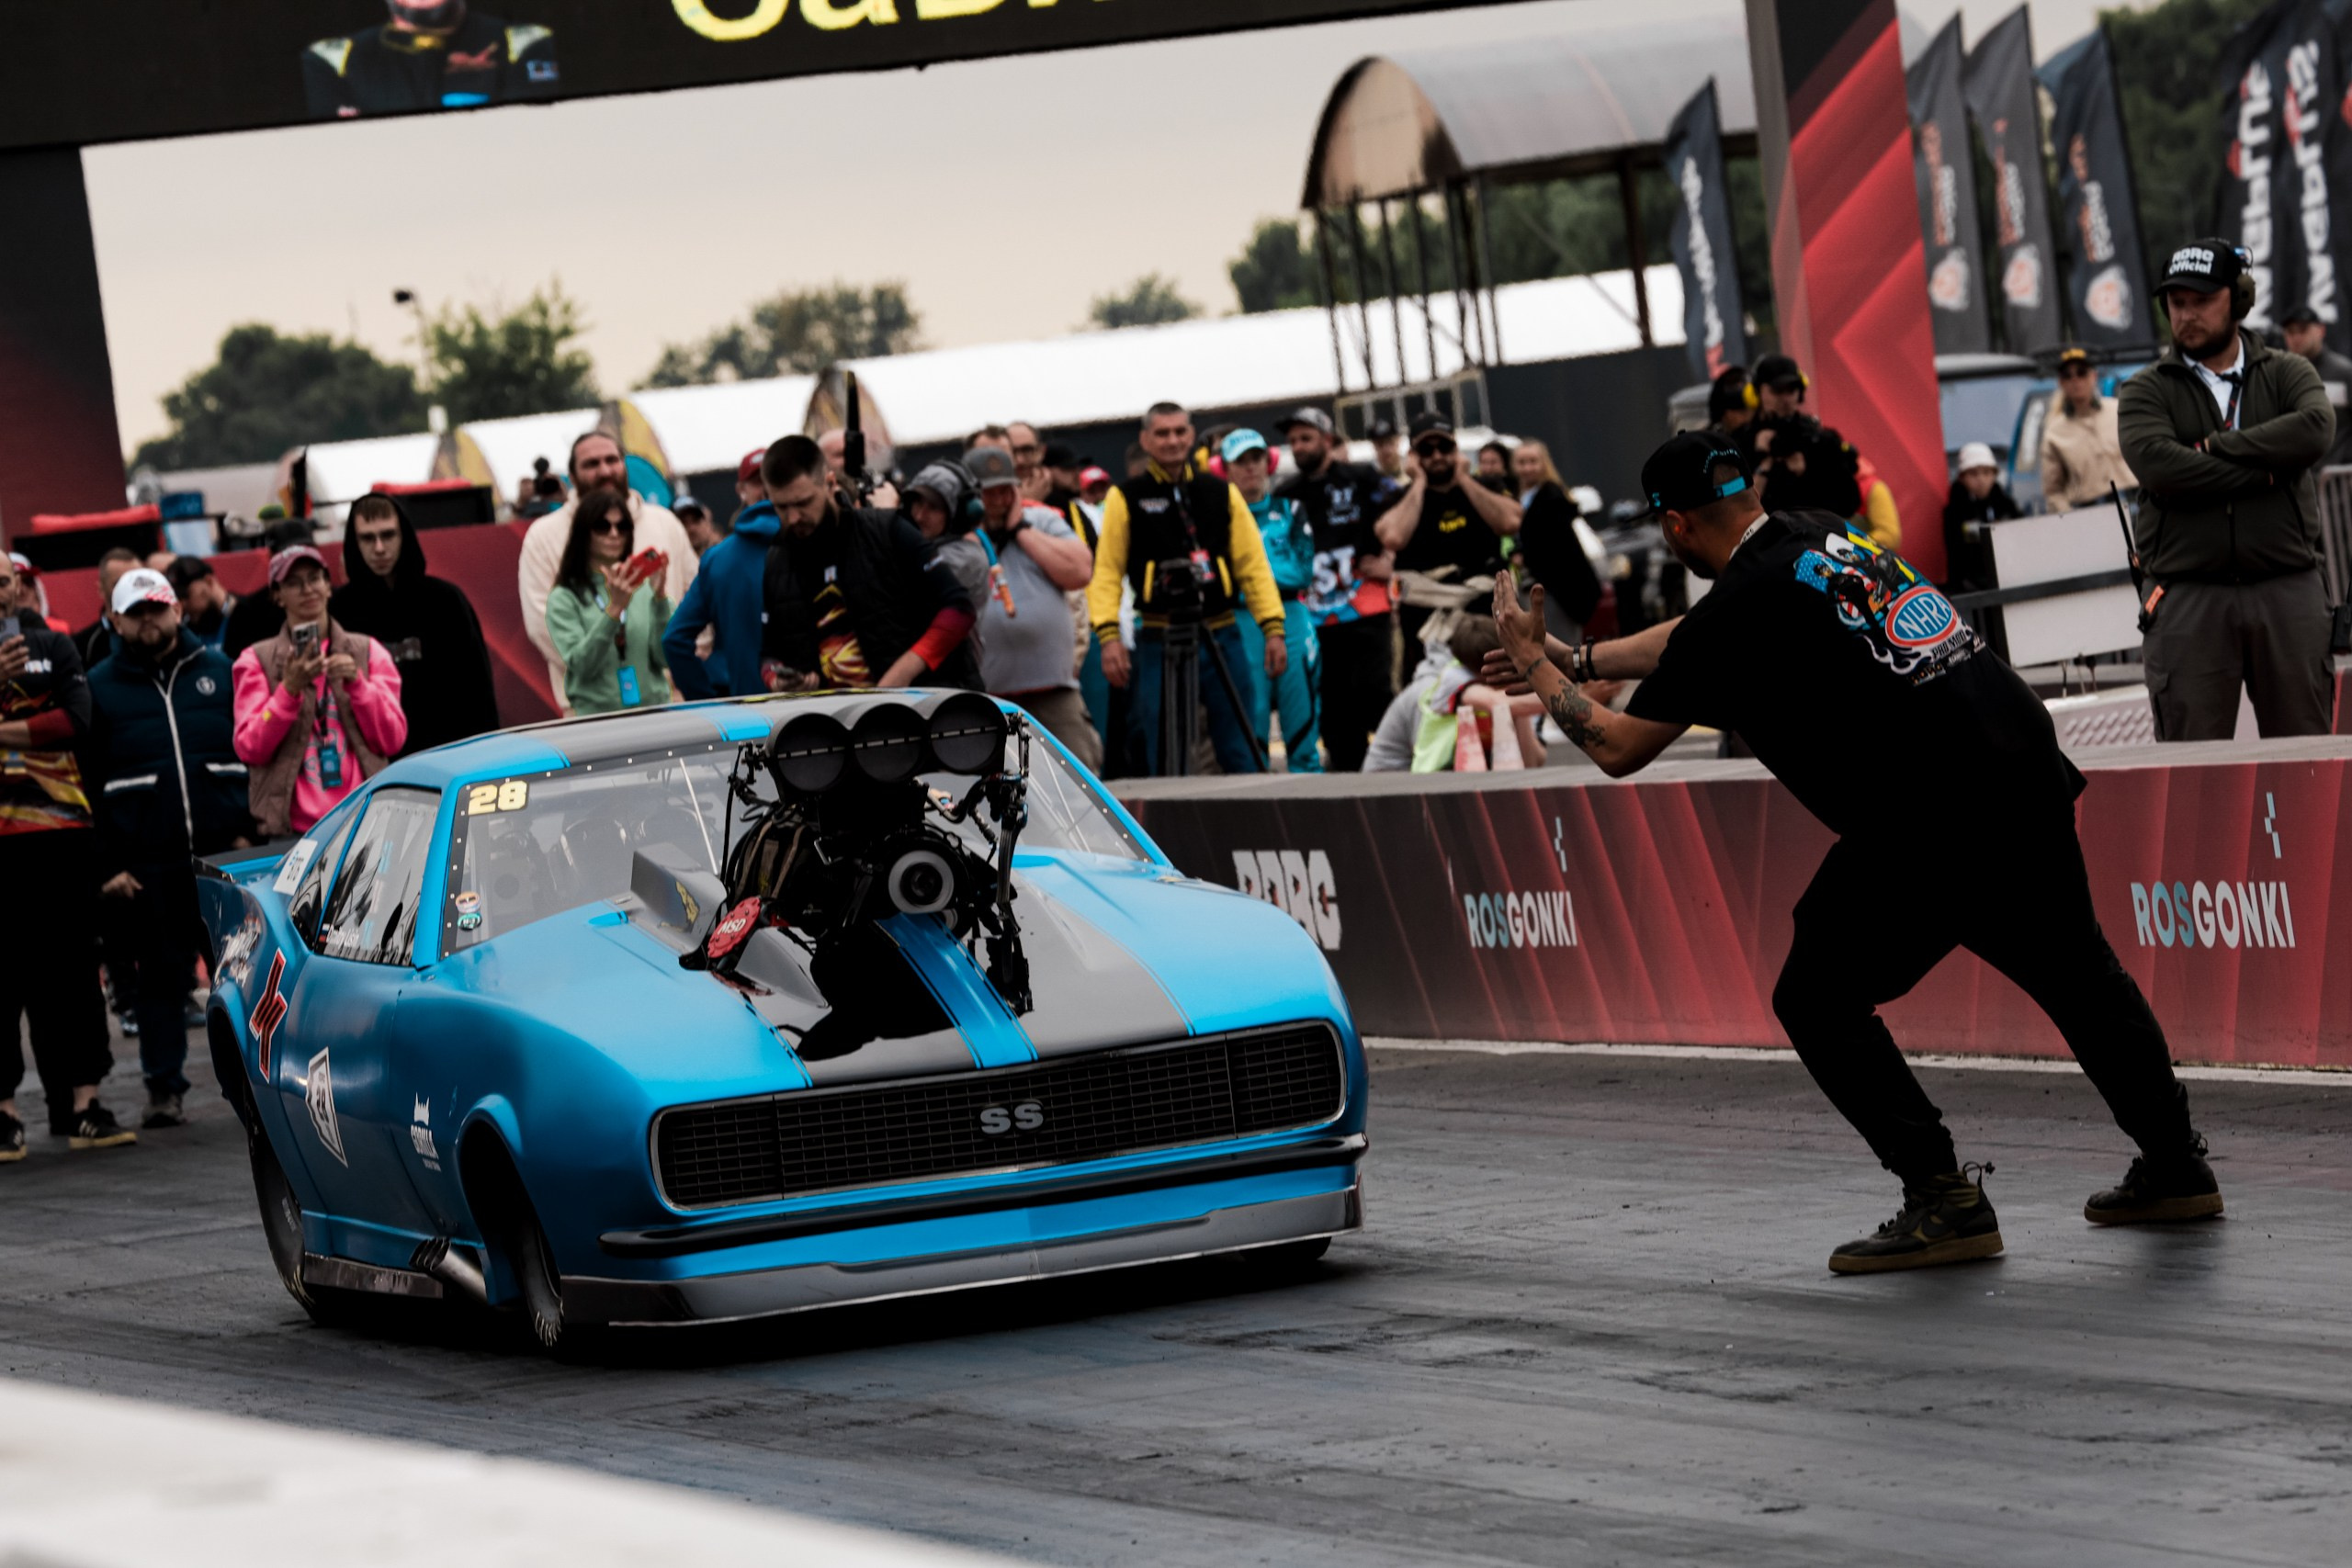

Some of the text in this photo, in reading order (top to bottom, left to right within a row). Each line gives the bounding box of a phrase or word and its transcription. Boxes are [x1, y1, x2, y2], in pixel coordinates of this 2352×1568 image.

[2169, 260, 2212, 275] Official
[1897, 592, 1951, 637] NHRA
[468, 780, 527, 816] 28
[718, 919, 746, 935] MSD
[1464, 890, 1577, 949] ROSGONKI
[2131, 879, 2296, 949] ROSGONKI
[979, 1102, 1044, 1134] SS
